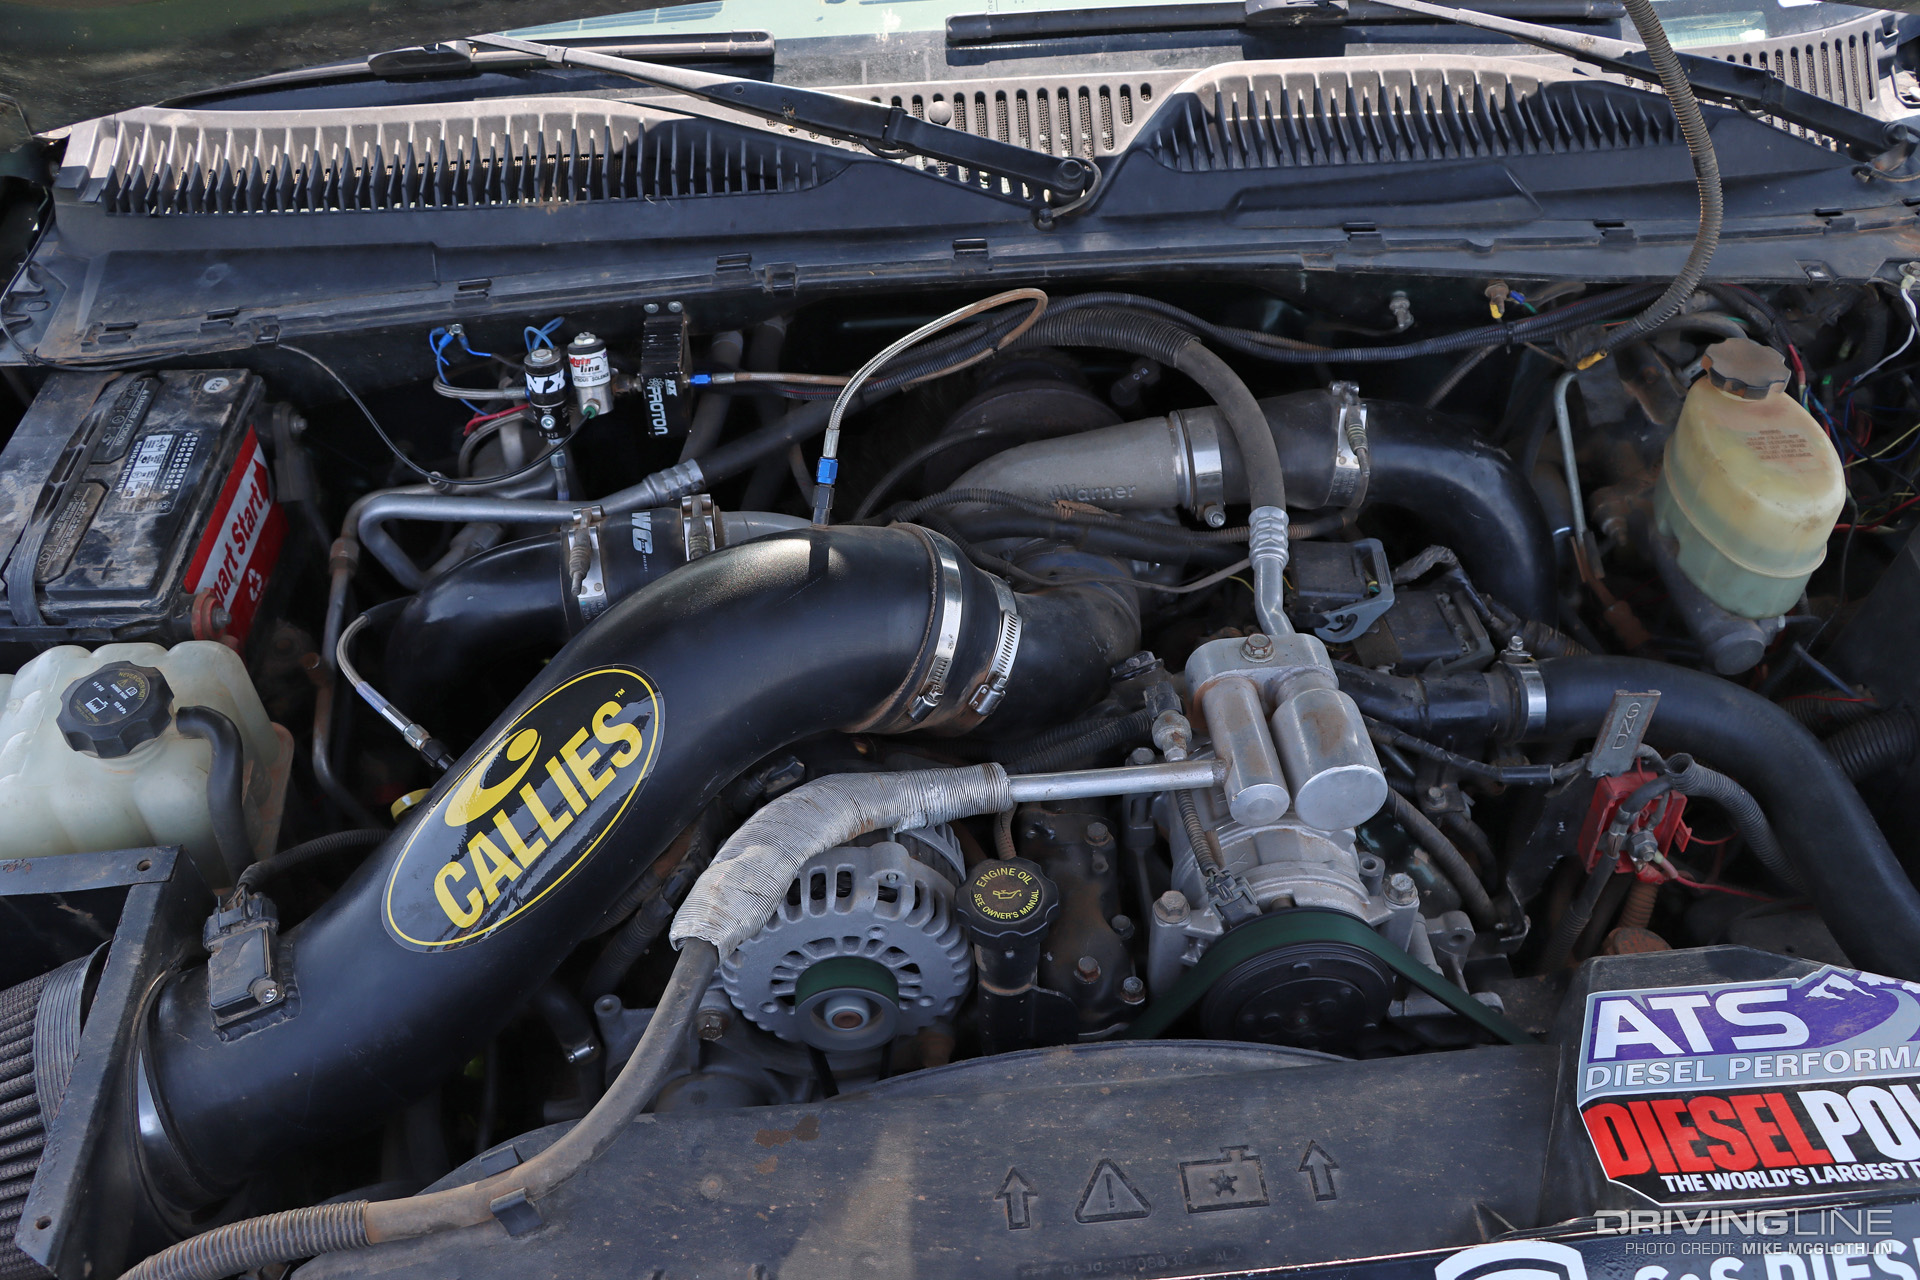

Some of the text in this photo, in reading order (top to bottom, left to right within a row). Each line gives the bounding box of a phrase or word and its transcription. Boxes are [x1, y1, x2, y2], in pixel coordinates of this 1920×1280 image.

[525, 368, 566, 394] NX
[1050, 483, 1137, 501] Warner
[231, 482, 263, 555] Start
[1612, 702, 1641, 750] GND
[433, 701, 643, 929] CALLIES
[976, 867, 1033, 888] ENGINE OIL
[974, 889, 1039, 919] SEE OWNER'S MANUAL
[1593, 988, 1810, 1060] ATS
[1584, 1060, 1716, 1093] DIESEL
[1660, 1173, 1708, 1193] THE
[1705, 1168, 1809, 1192] WORLD'S
[1812, 1162, 1910, 1185] LARGEST
